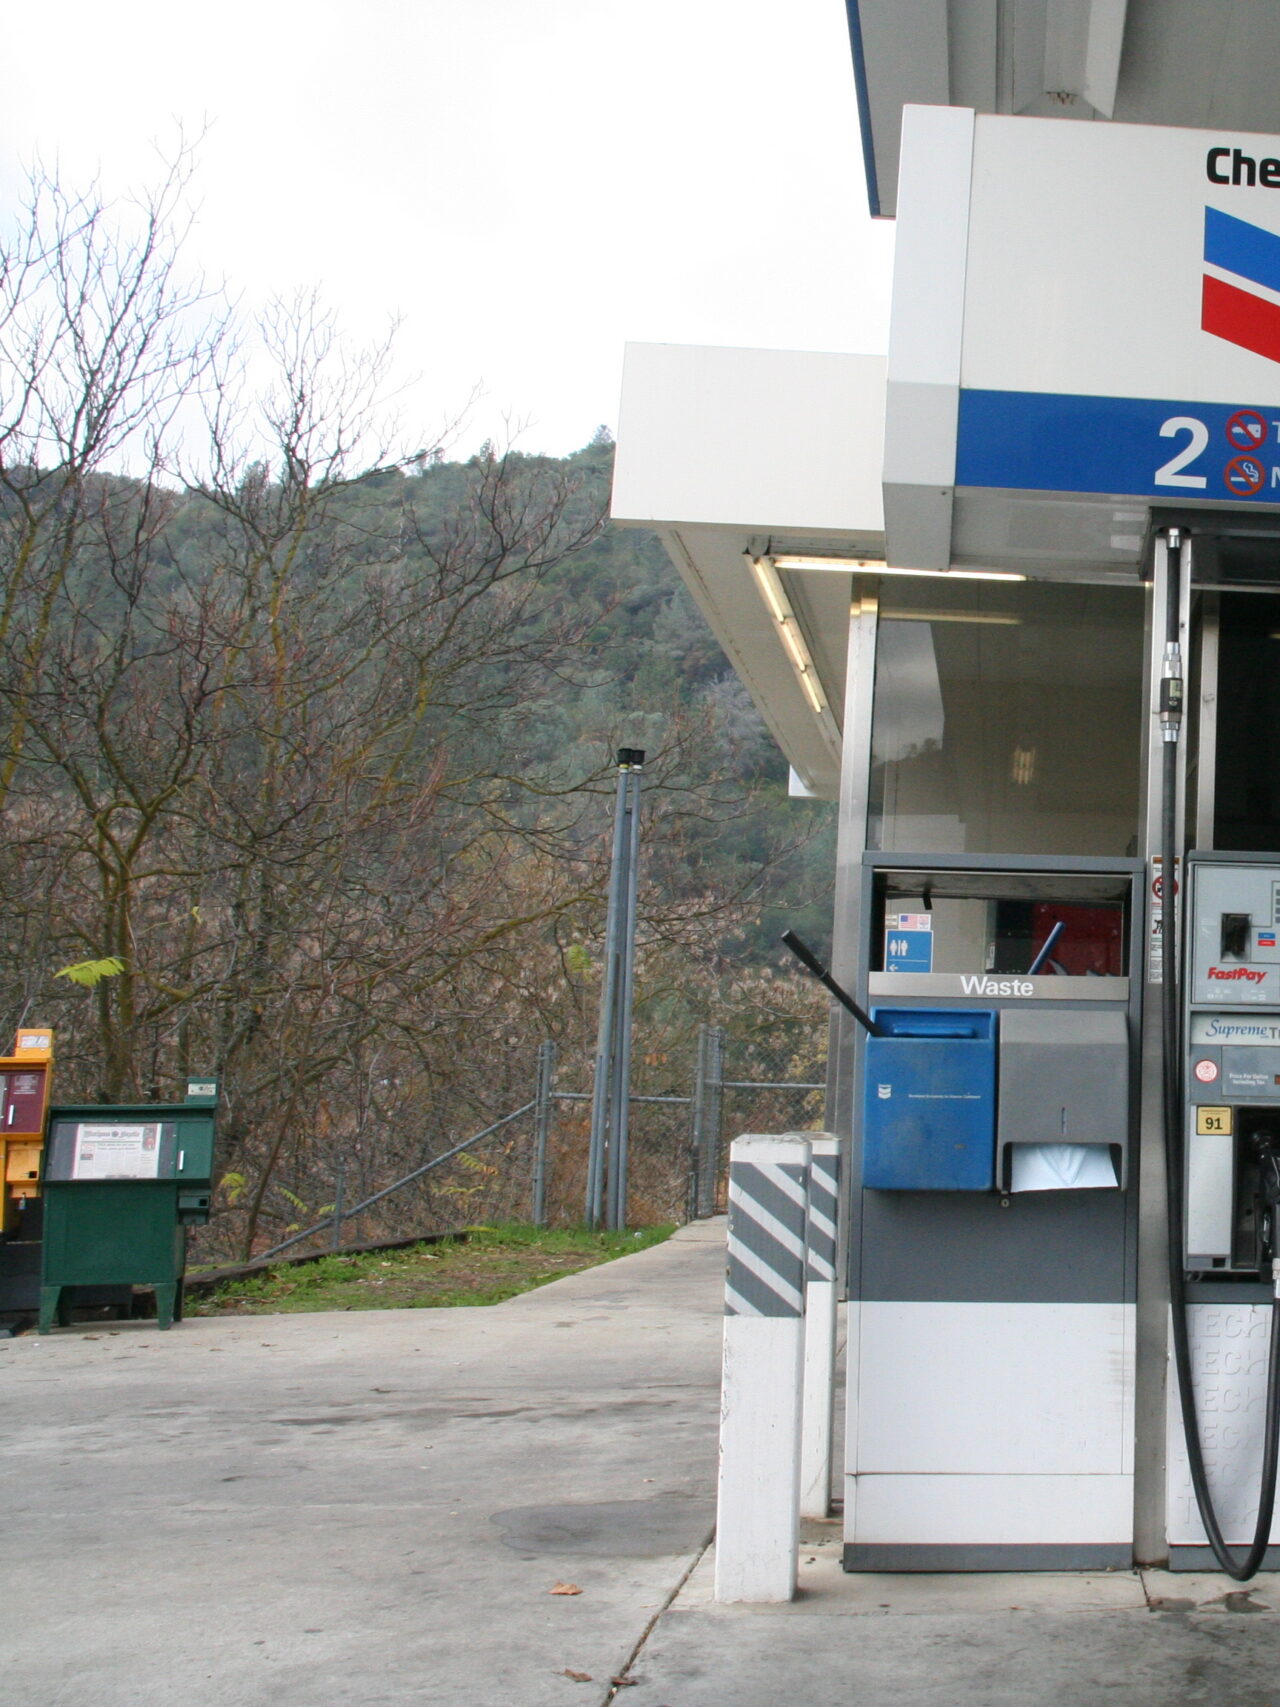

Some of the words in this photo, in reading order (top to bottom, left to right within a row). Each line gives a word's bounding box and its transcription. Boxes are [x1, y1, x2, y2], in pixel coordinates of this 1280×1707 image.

[1154, 416, 1209, 489] 2
[1207, 967, 1268, 984] FastPay
[960, 976, 1034, 996] Waste
[1205, 1018, 1268, 1038] Supreme
[1205, 1117, 1222, 1130] 91
